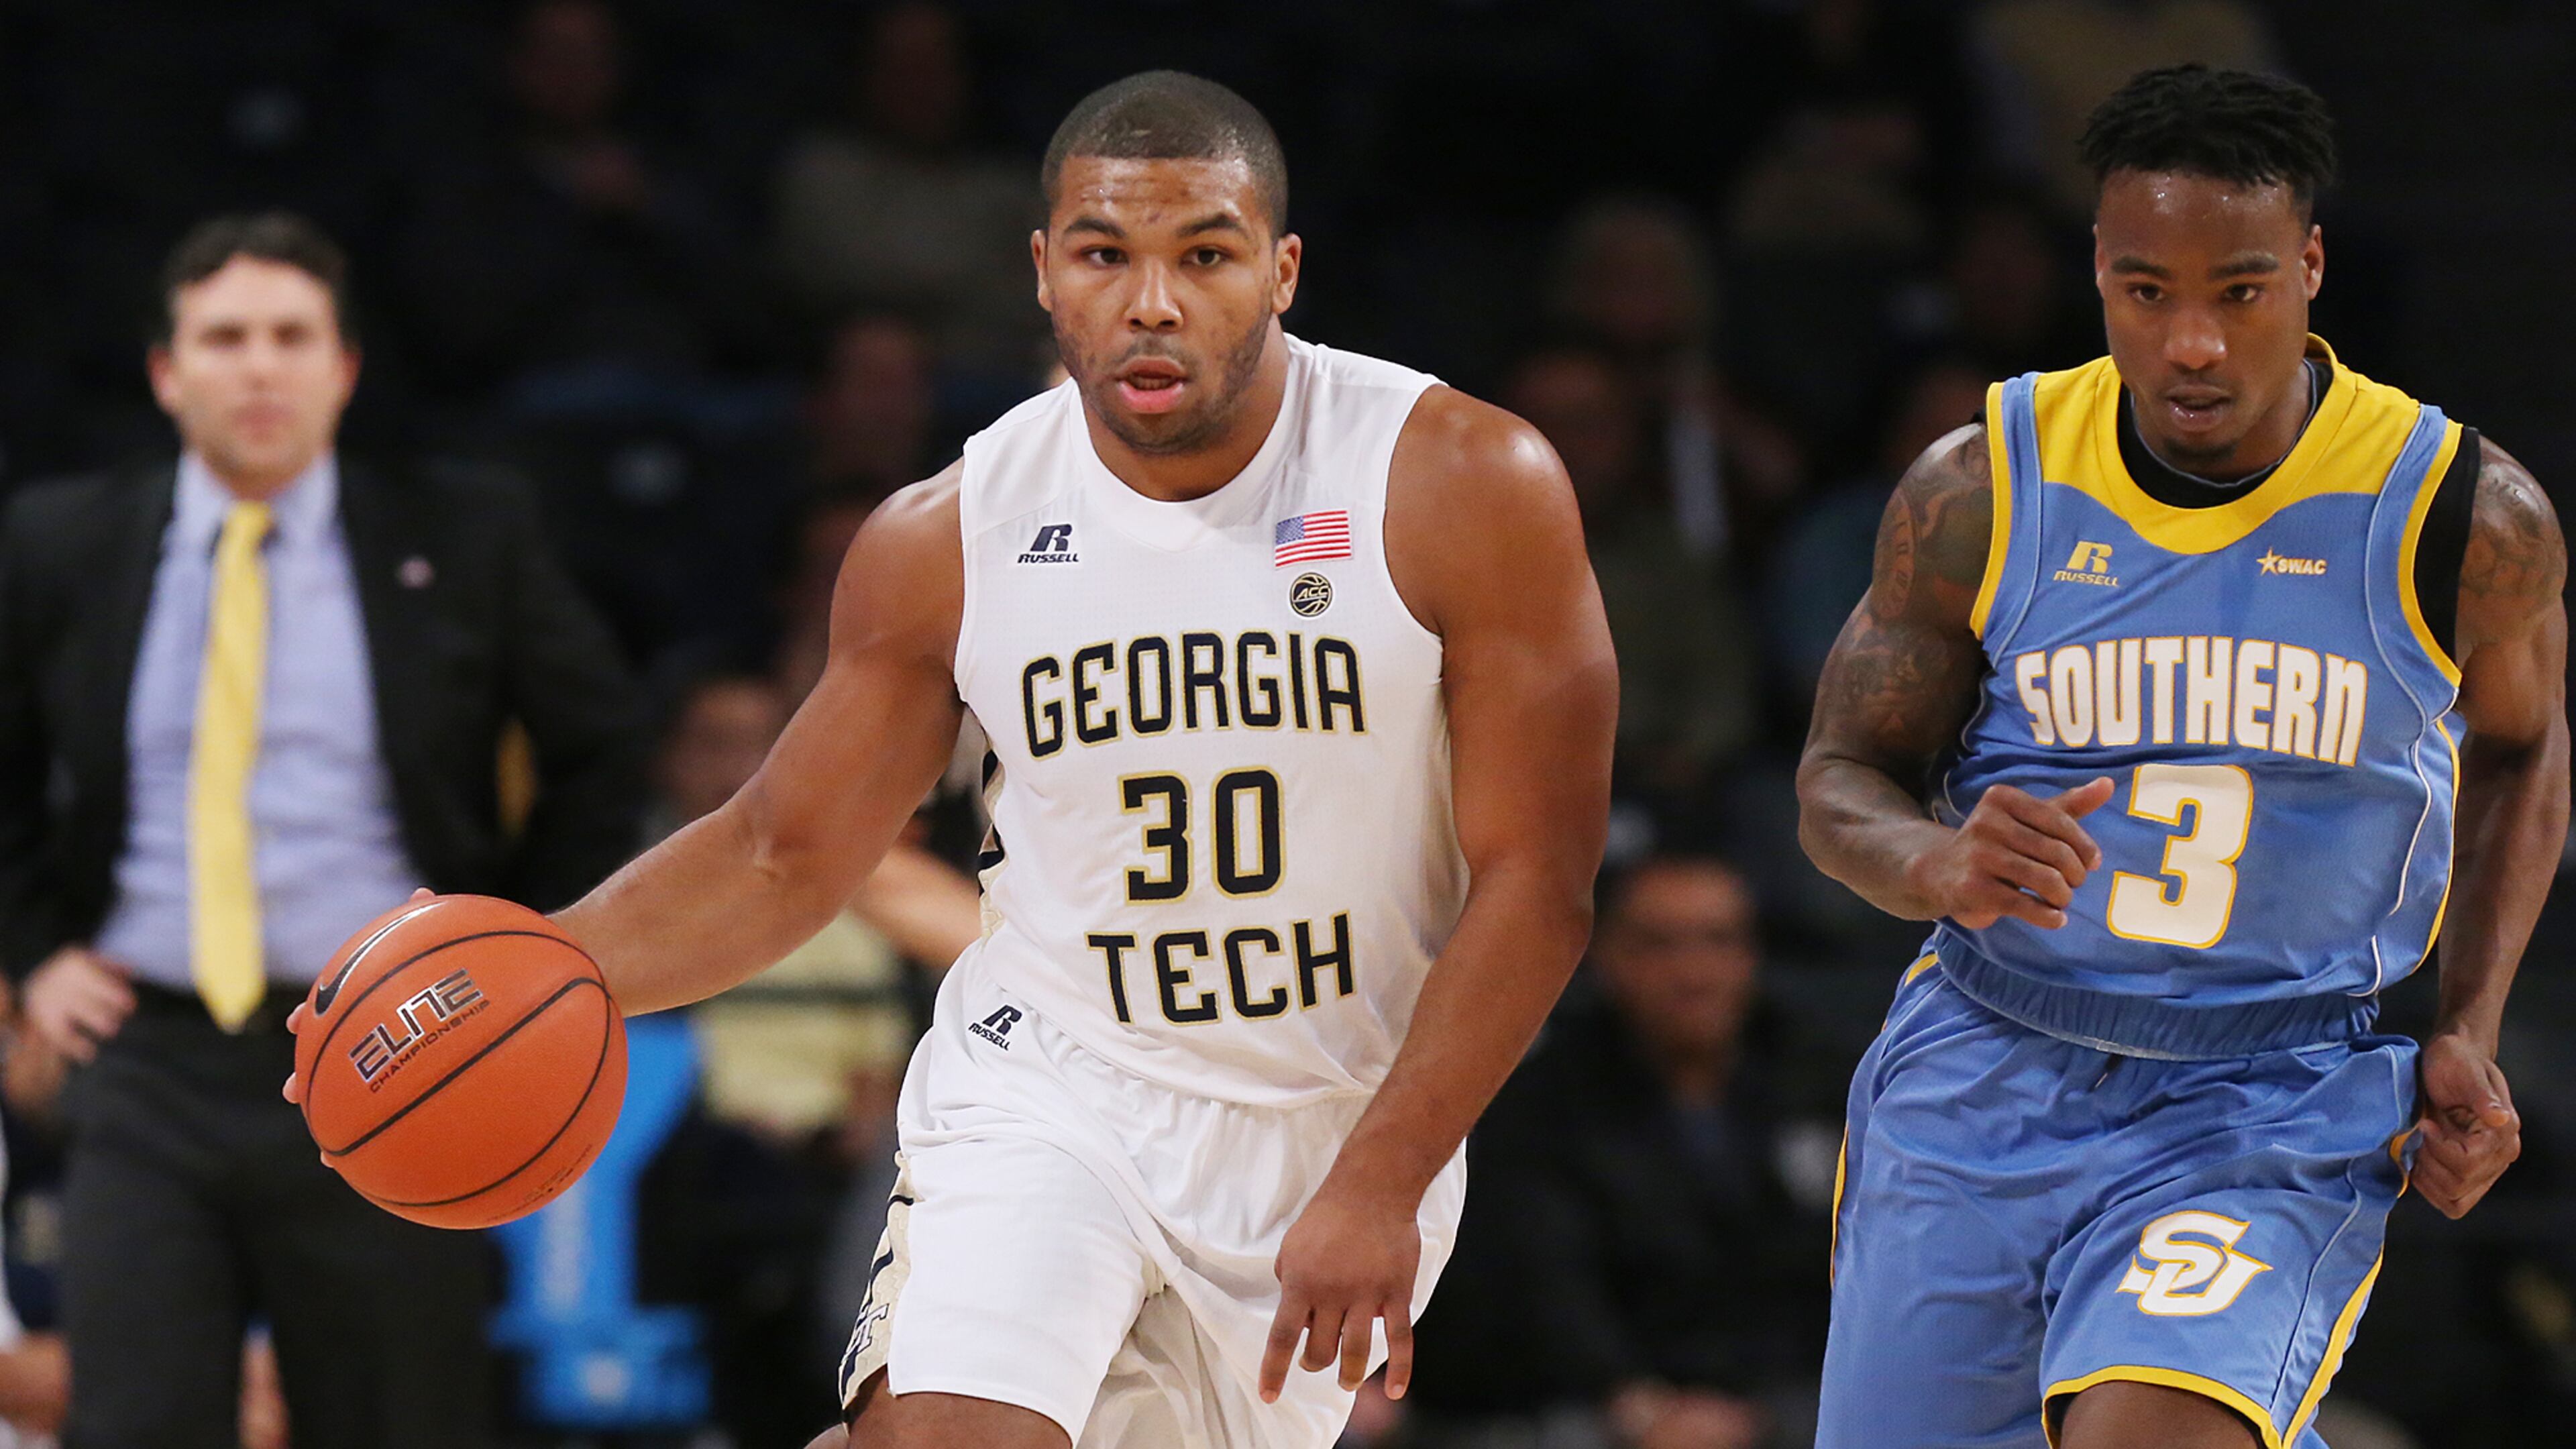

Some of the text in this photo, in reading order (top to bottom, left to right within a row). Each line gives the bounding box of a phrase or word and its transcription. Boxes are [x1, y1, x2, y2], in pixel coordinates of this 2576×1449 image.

[1017, 553, 1079, 564] RUSSELL
[1030, 523, 1073, 552] R
[2066, 541, 2113, 574] R
[2276, 557, 2327, 576] SWAC
[1295, 585, 1329, 600] ACC
[2053, 571, 2118, 586] RUSSELL
[1020, 629, 1368, 761] GEORGIA
[2015, 636, 2367, 767] SOUTHERN
[1118, 765, 1286, 906] 30
[2106, 763, 2255, 950] 3
[1084, 910, 1358, 1026] TECH
[348, 967, 484, 1083] ELITE
[370, 999, 490, 1093] CHAMPIONSHIP
[968, 1022, 1010, 1051] RUSSELL
[982, 1004, 1022, 1036] R
[2116, 1210, 2274, 1317] SU
